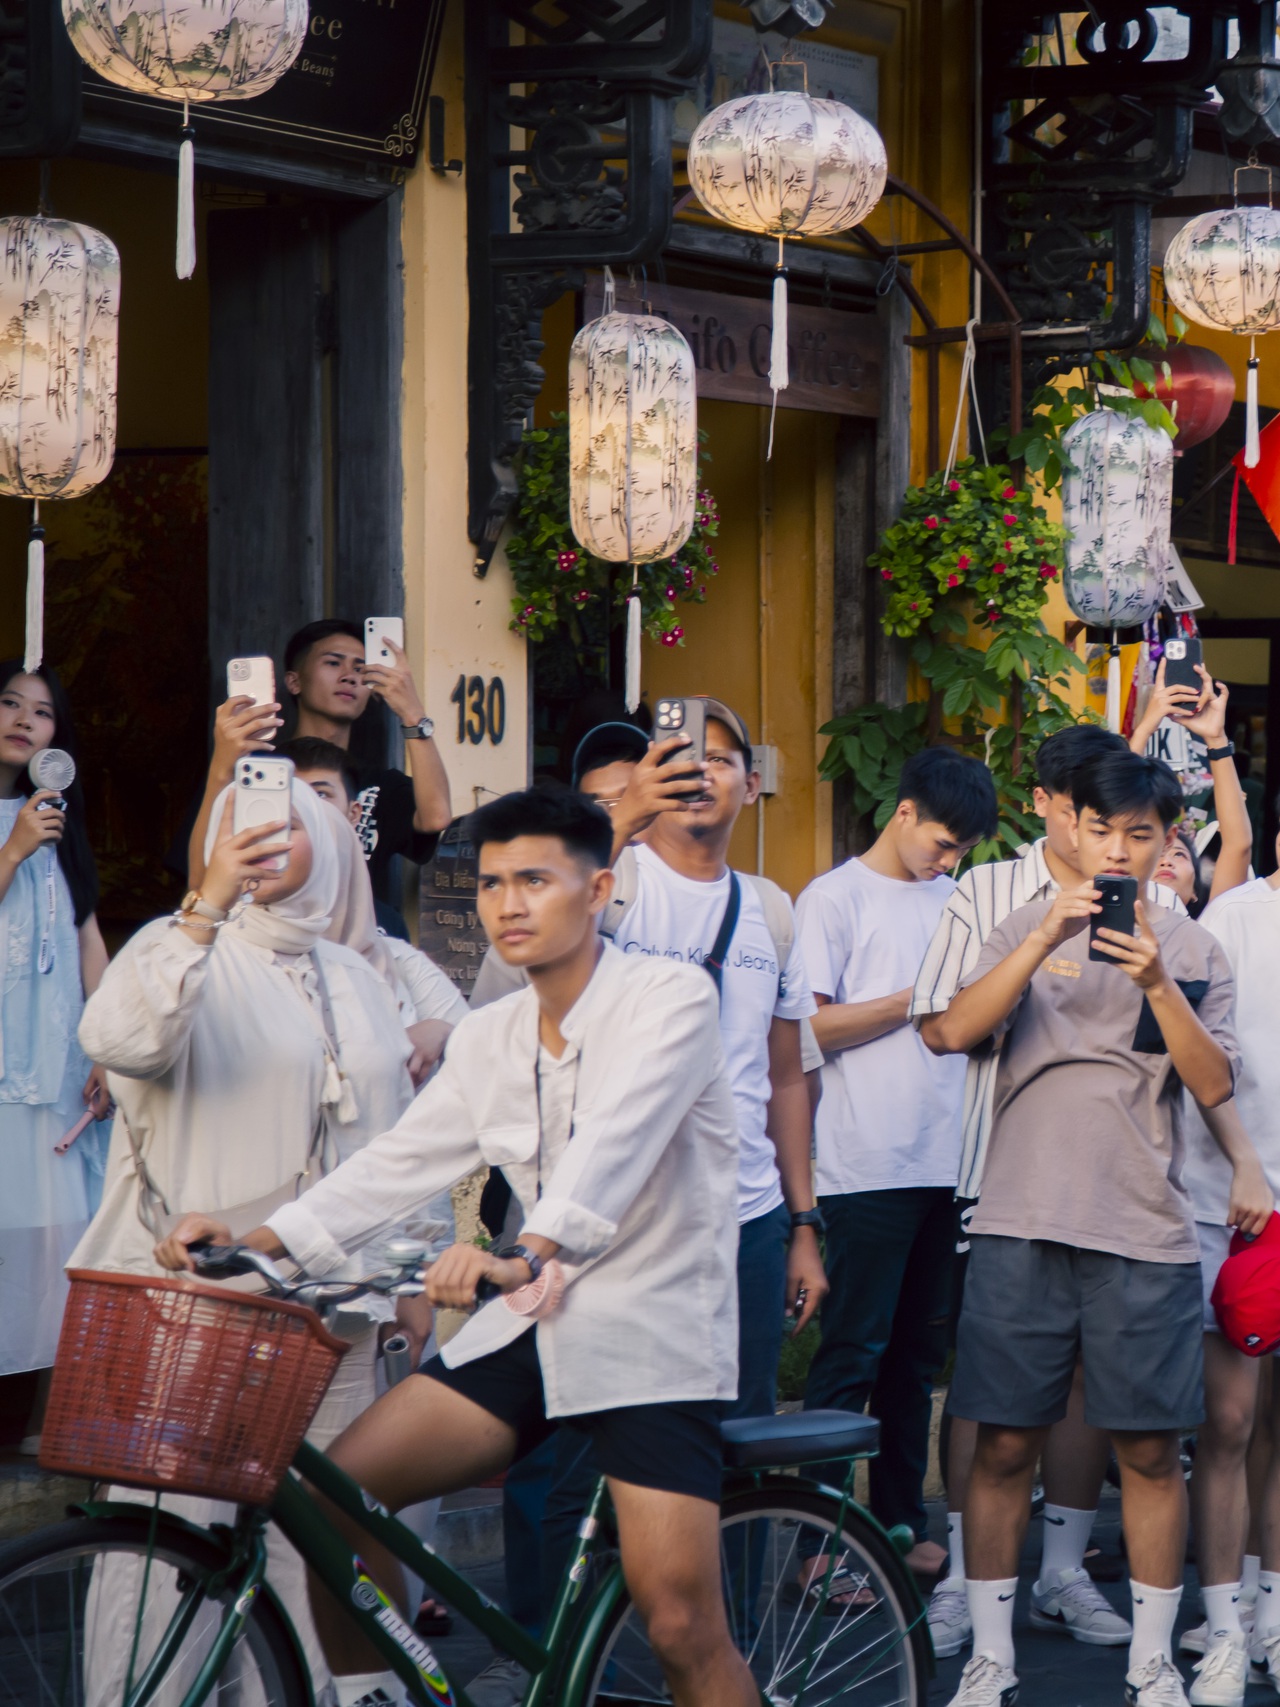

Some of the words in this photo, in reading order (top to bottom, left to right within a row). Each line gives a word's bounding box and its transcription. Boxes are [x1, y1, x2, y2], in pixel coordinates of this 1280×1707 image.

[301, 58, 335, 77] Beans
[749, 323, 863, 391] Cffee
[450, 674, 505, 746] 130
[733, 950, 777, 975] Jeans
[374, 1605, 439, 1675] martin
